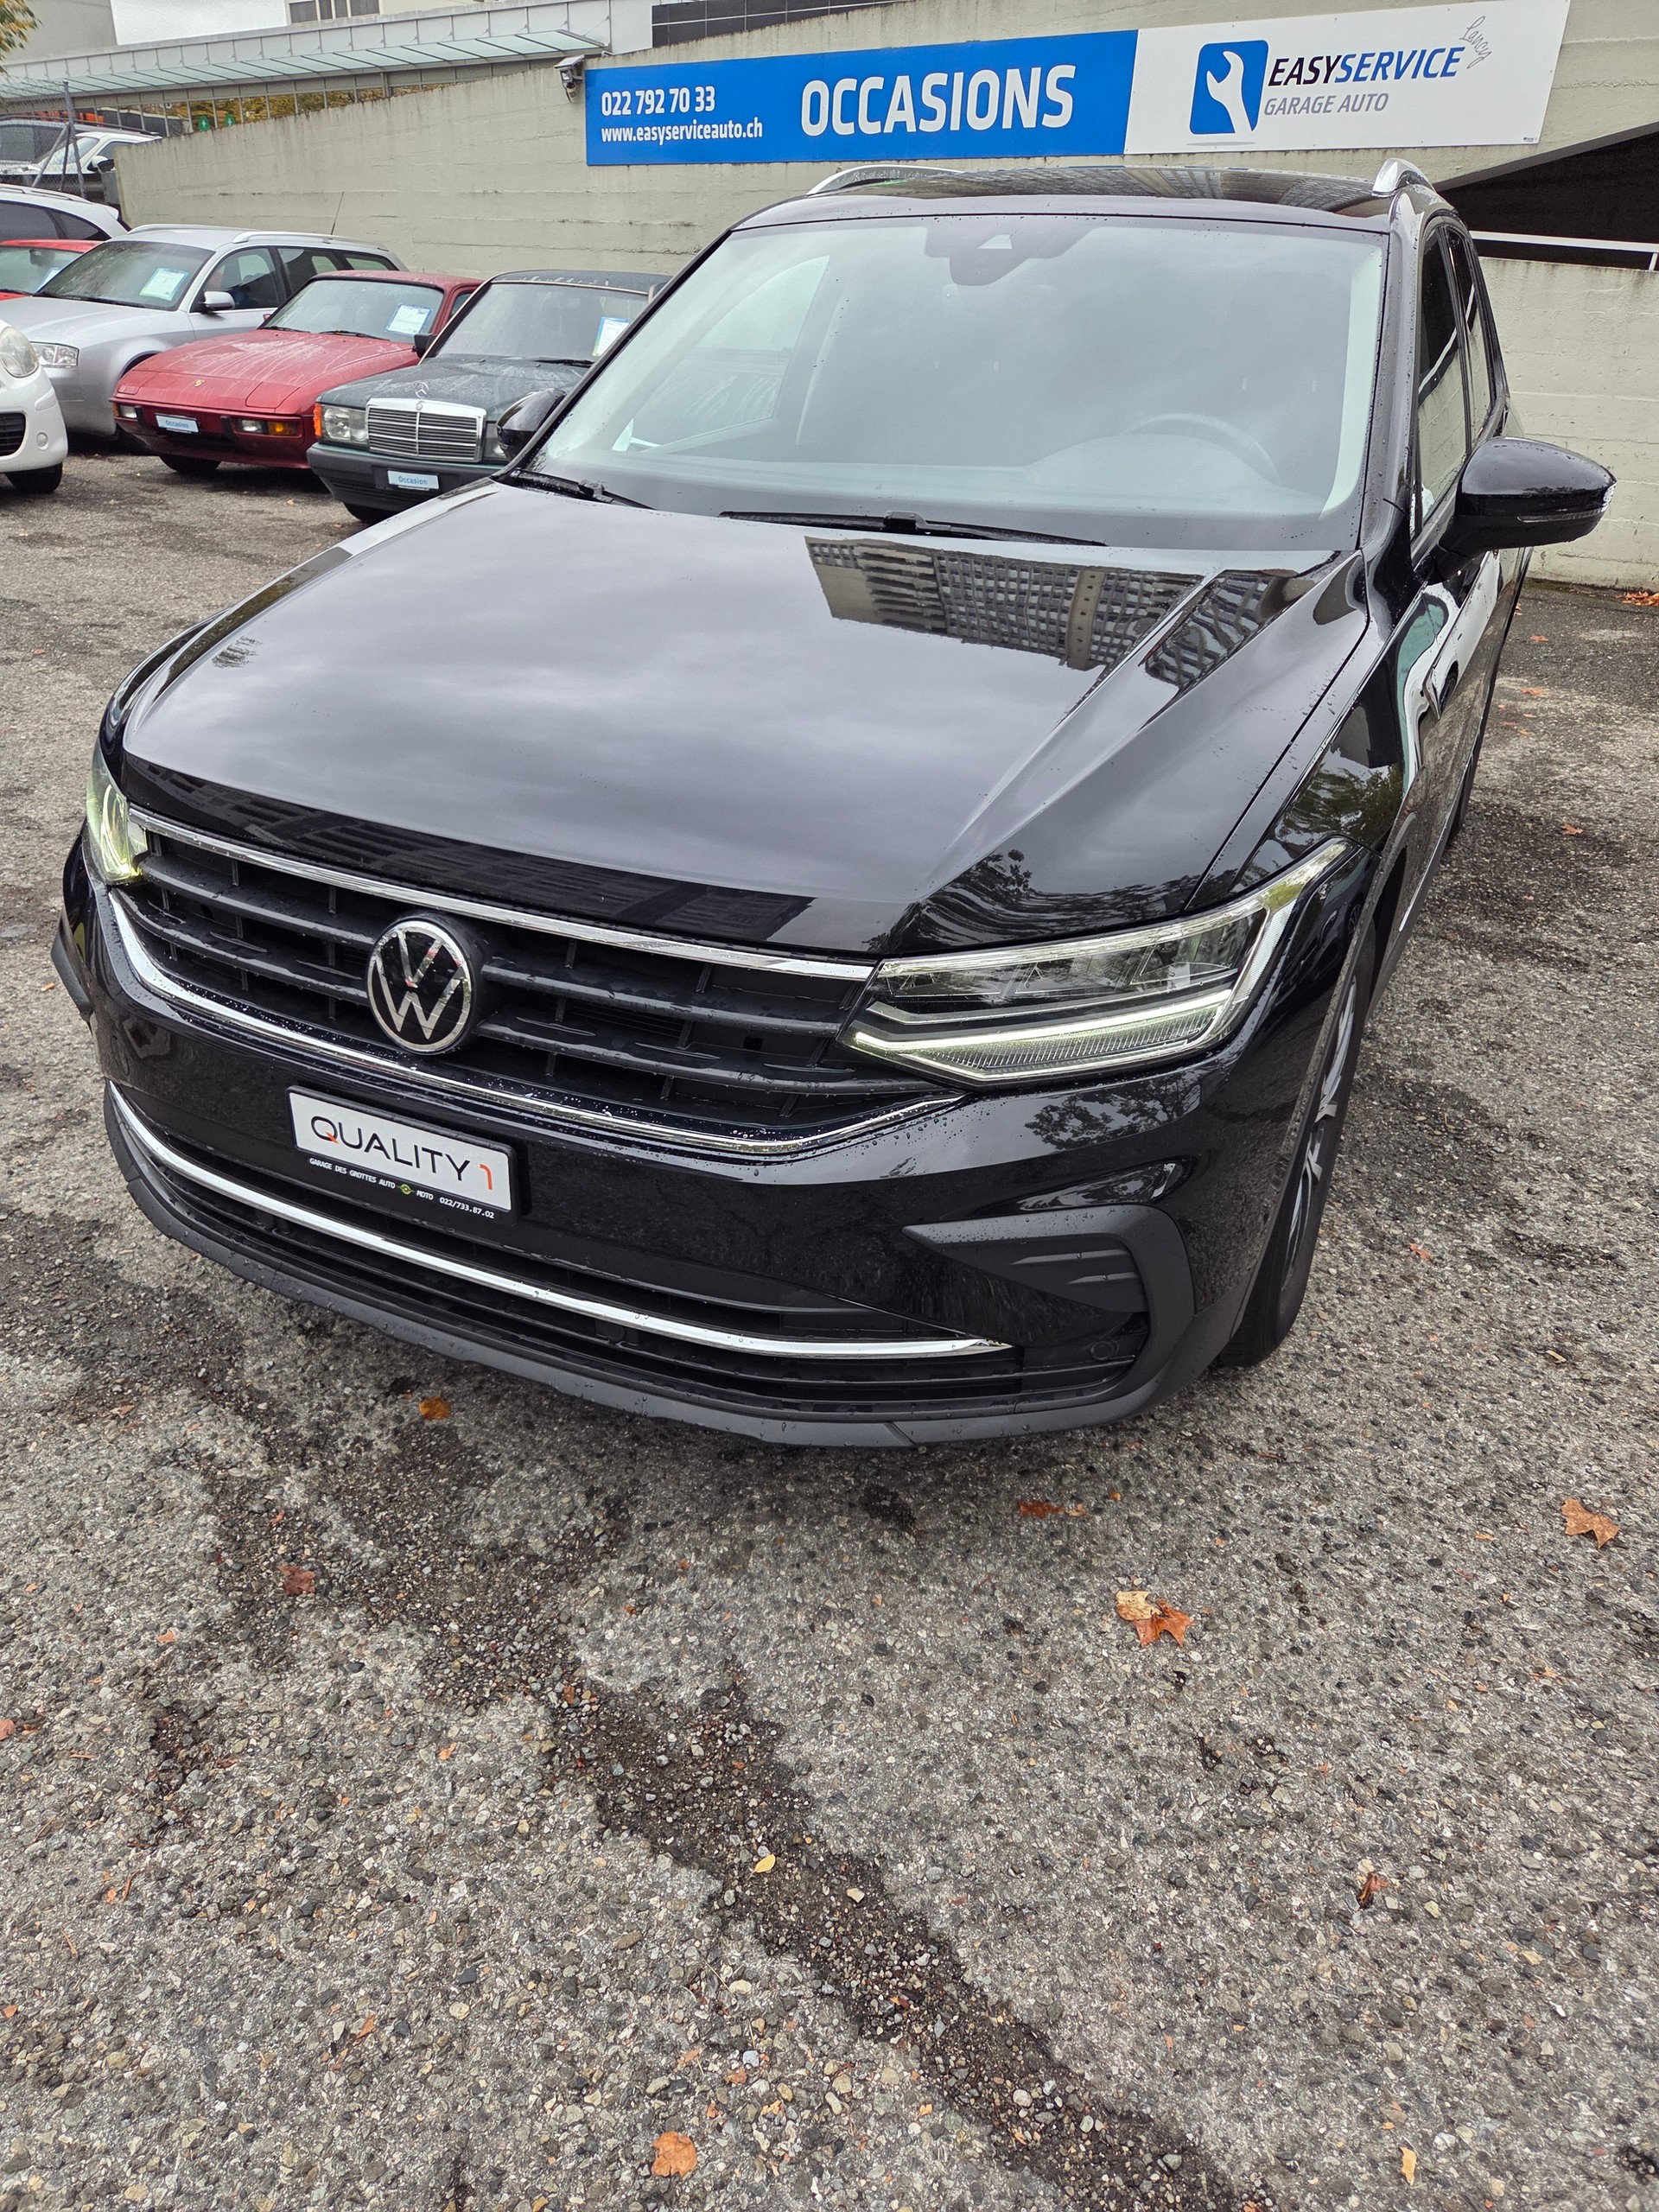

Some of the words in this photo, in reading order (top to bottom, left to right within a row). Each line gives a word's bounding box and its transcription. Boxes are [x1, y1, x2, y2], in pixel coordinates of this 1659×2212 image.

[1459, 16, 1492, 69] Lancy
[1268, 47, 1465, 86] EASYSERVICE
[601, 91, 632, 117] 022
[635, 89, 665, 115] 792
[669, 87, 690, 113] 70
[695, 86, 715, 112] 33
[801, 65, 1076, 137] OCCASIONS
[1264, 95, 1337, 116] GARAGE
[1338, 92, 1389, 113] AUTO
[601, 116, 763, 146] www.easyserviceauto.ch
[398, 475, 429, 486] Occasion
[309, 1158, 333, 1170] GARAGE
[334, 1165, 347, 1174] DES
[349, 1169, 377, 1184] GROTTES
[378, 1179, 396, 1189] AUTO
[416, 1190, 434, 1201] MOTO
[439, 1197, 495, 1219] 022/733.87.02
